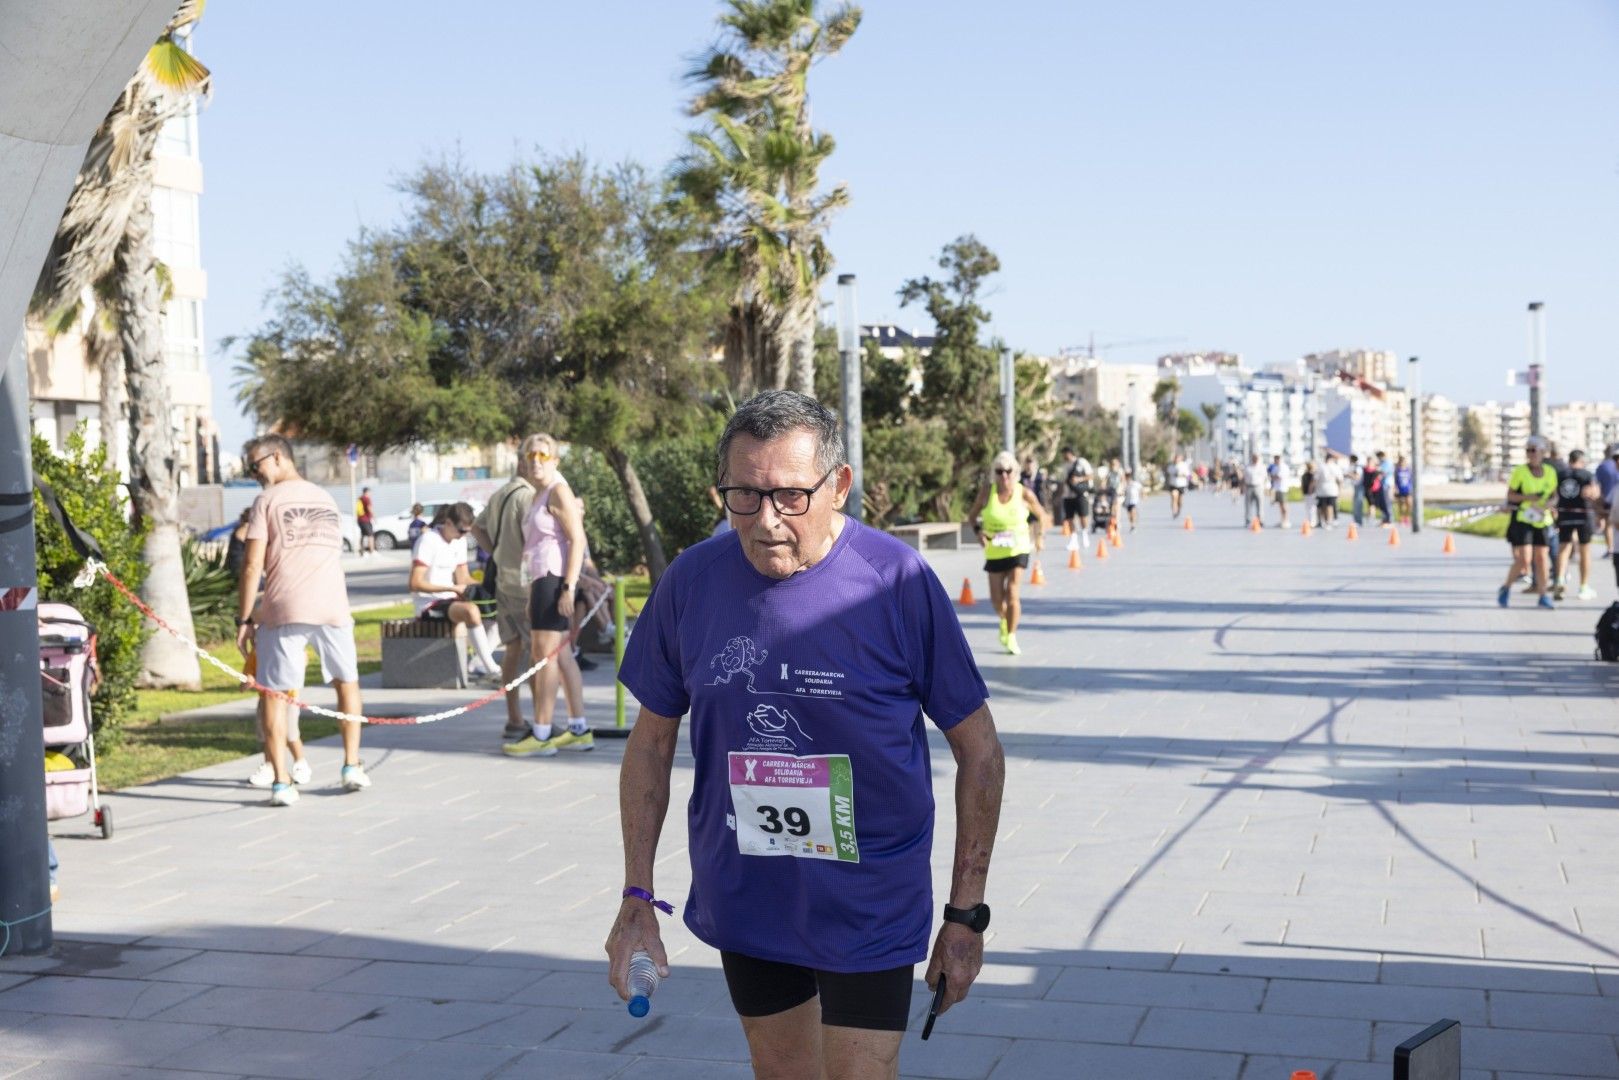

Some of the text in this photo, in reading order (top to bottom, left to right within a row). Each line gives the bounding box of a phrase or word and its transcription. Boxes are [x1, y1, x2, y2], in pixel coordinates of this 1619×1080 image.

[794, 669, 845, 679] CARRERA/MARCHA
[804, 677, 833, 685] SOLIDARIA
[809, 688, 842, 696] TORREVIEJA
[762, 760, 816, 769] CARRERA/MARCHA
[744, 758, 758, 782] X
[774, 768, 803, 777] SOLIDARIA
[777, 776, 813, 785] TORREVIEJA
[834, 795, 852, 828] KM
[756, 805, 811, 837] 39
